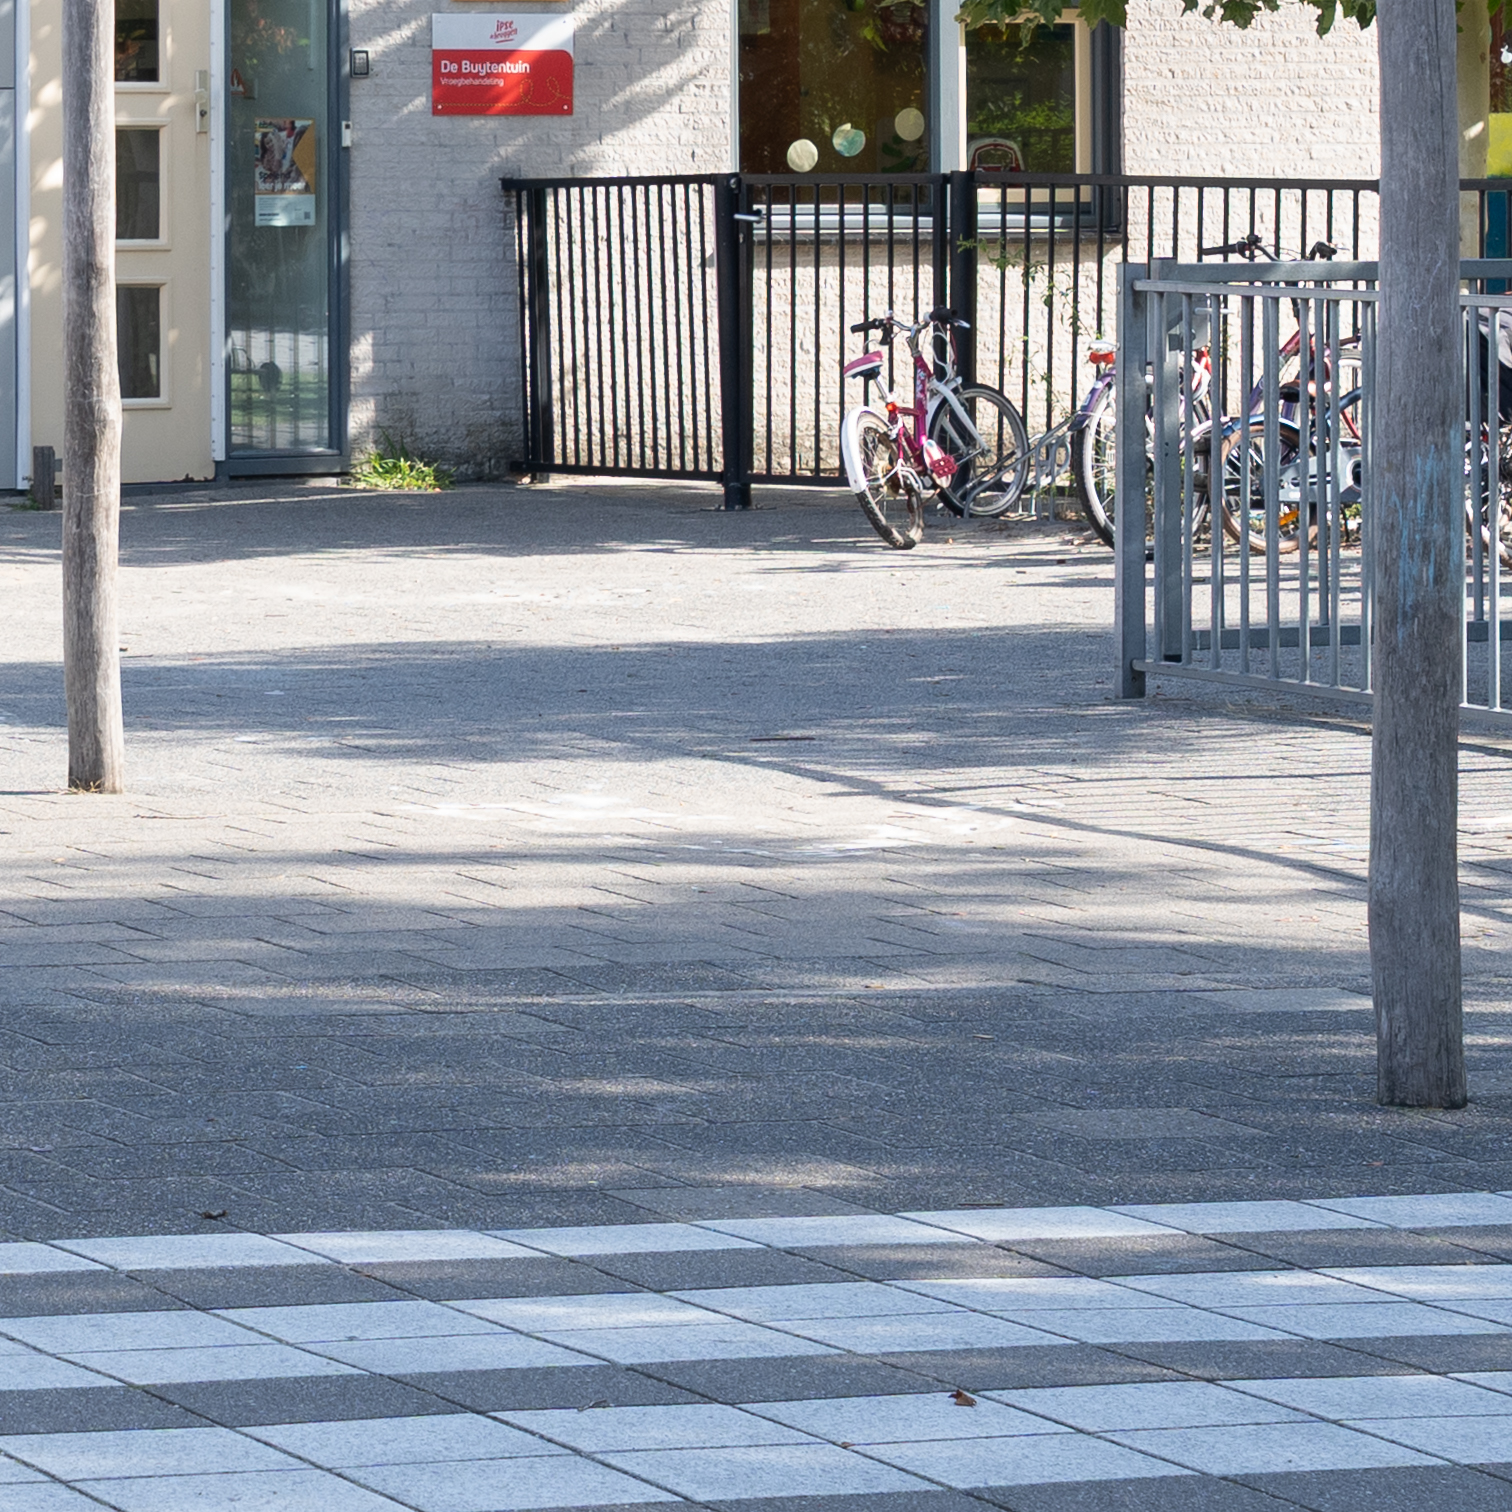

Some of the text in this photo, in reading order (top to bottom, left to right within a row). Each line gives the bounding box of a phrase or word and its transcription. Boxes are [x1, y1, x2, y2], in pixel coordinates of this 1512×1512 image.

[496, 19, 514, 32] ipse
[440, 60, 530, 76] De Buytentuin
[440, 77, 504, 87] Vroegbehandeling
